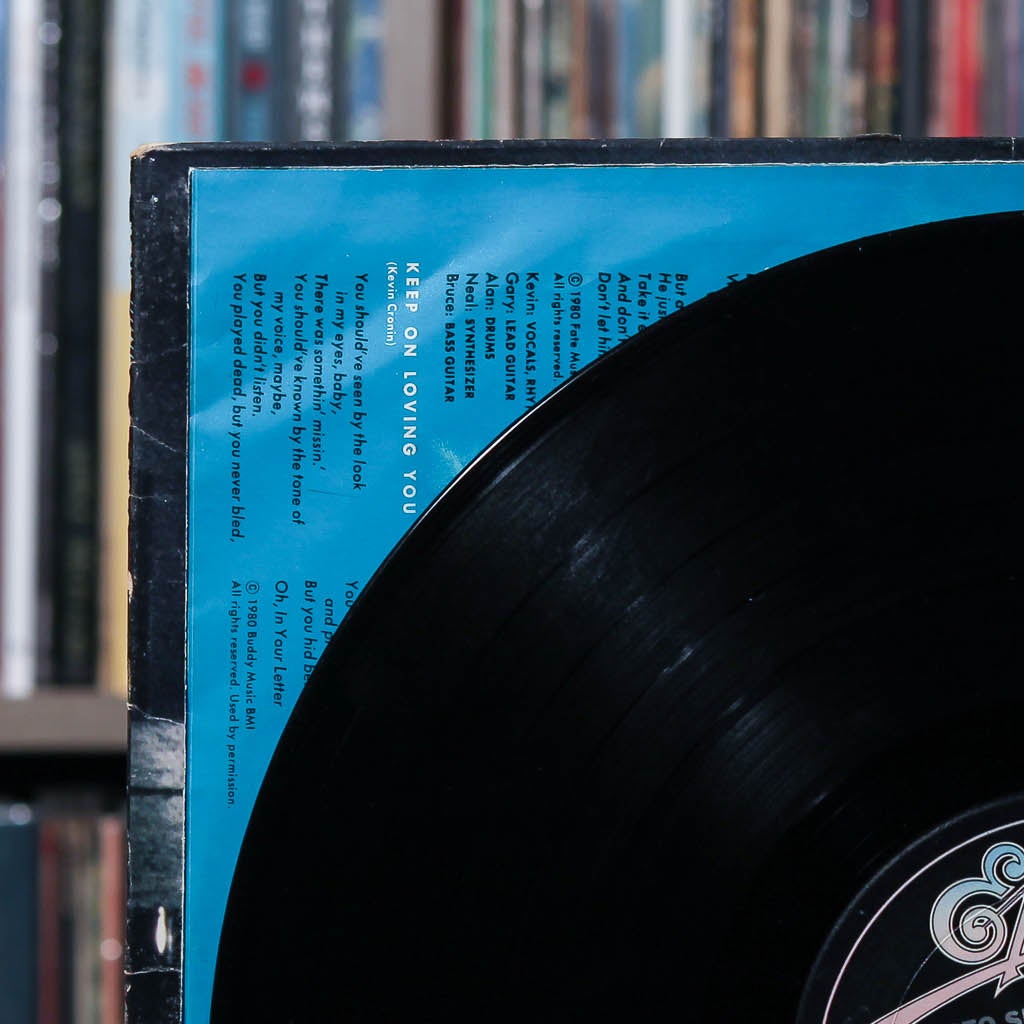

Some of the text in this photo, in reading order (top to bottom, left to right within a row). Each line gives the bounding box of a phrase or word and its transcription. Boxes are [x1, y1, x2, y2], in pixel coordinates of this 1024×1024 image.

[254, 274, 267, 296] But
[294, 274, 307, 300] You
[314, 274, 328, 313] There
[355, 274, 368, 300] You
[385, 262, 397, 345] (Kevin Cronin)
[250, 301, 263, 326] you
[315, 318, 323, 345] was
[485, 273, 499, 359] Alan: DRUMS
[524, 273, 539, 374] Kevin: VOCALS,
[445, 274, 459, 402] Bruce: BASS GUITAR
[465, 273, 479, 398] Neal: SYNTHESIZER
[502, 272, 519, 400] Gary: LEAD GUITAR
[228, 273, 248, 542] You played dead, but you never bled,
[250, 375, 267, 416] listen.
[291, 376, 307, 423] known
[353, 376, 362, 407] seen
[403, 263, 421, 513] KEEP ON LOVING YOU
[289, 427, 306, 443] by
[350, 412, 367, 429] by
[292, 449, 306, 470] the
[353, 434, 367, 455] the
[292, 475, 304, 505] tone
[353, 460, 367, 490] look
[292, 511, 305, 525] of
[273, 581, 288, 707] Oh, In Your Letter
[244, 600, 257, 729] 1980 Buddy Music BMI
[226, 581, 242, 808] All rights reserved. Used by permission.
